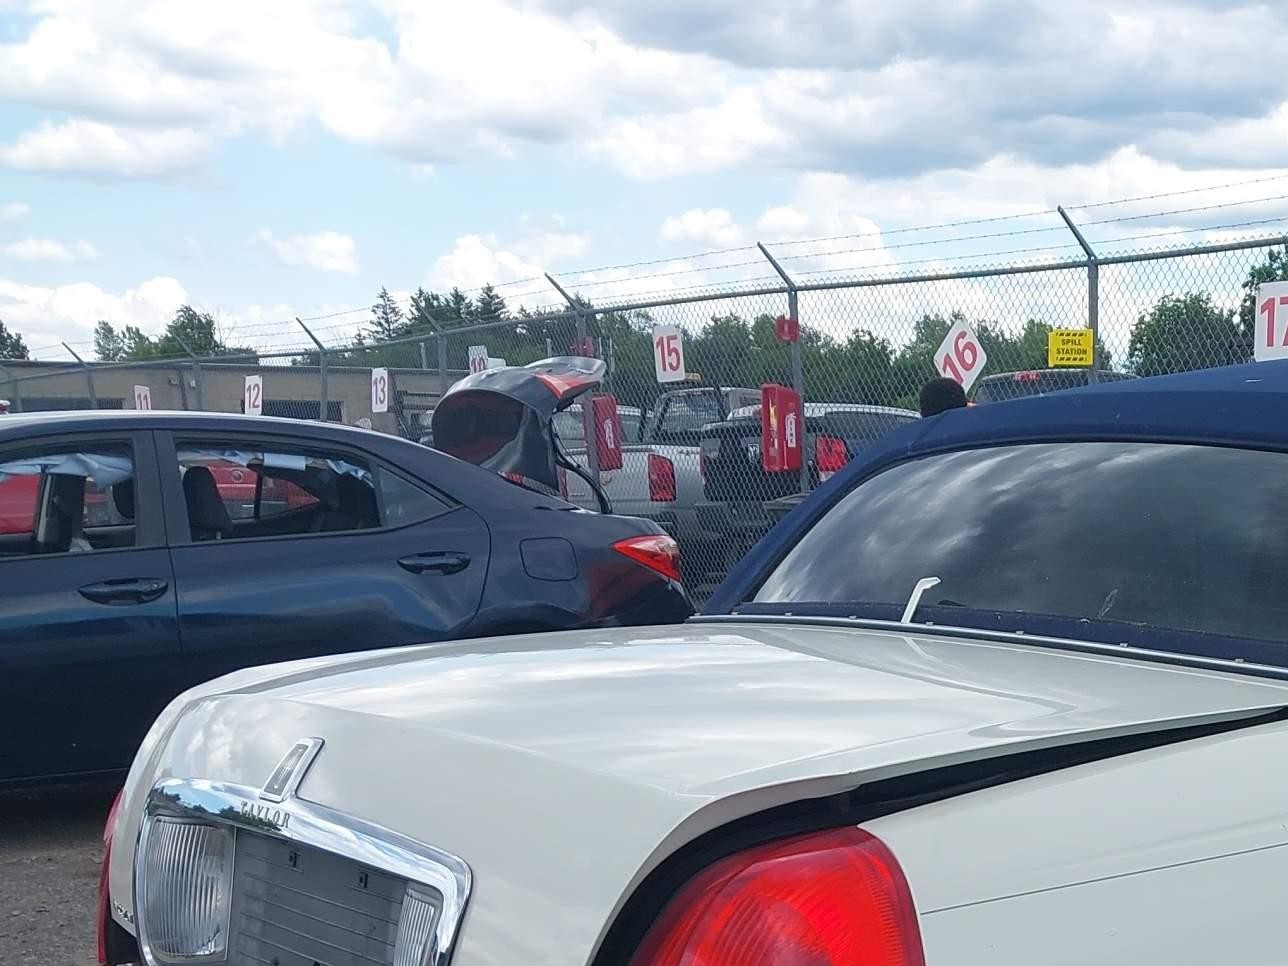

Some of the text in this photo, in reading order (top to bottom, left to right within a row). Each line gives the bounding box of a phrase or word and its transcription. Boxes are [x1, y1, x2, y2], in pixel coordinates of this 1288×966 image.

[655, 334, 682, 373] 15
[1056, 347, 1088, 356] STATION
[1061, 338, 1082, 346] SPILL
[942, 330, 978, 385] 16
[136, 392, 150, 411] 11
[246, 383, 261, 410] 12
[372, 376, 386, 405] 13
